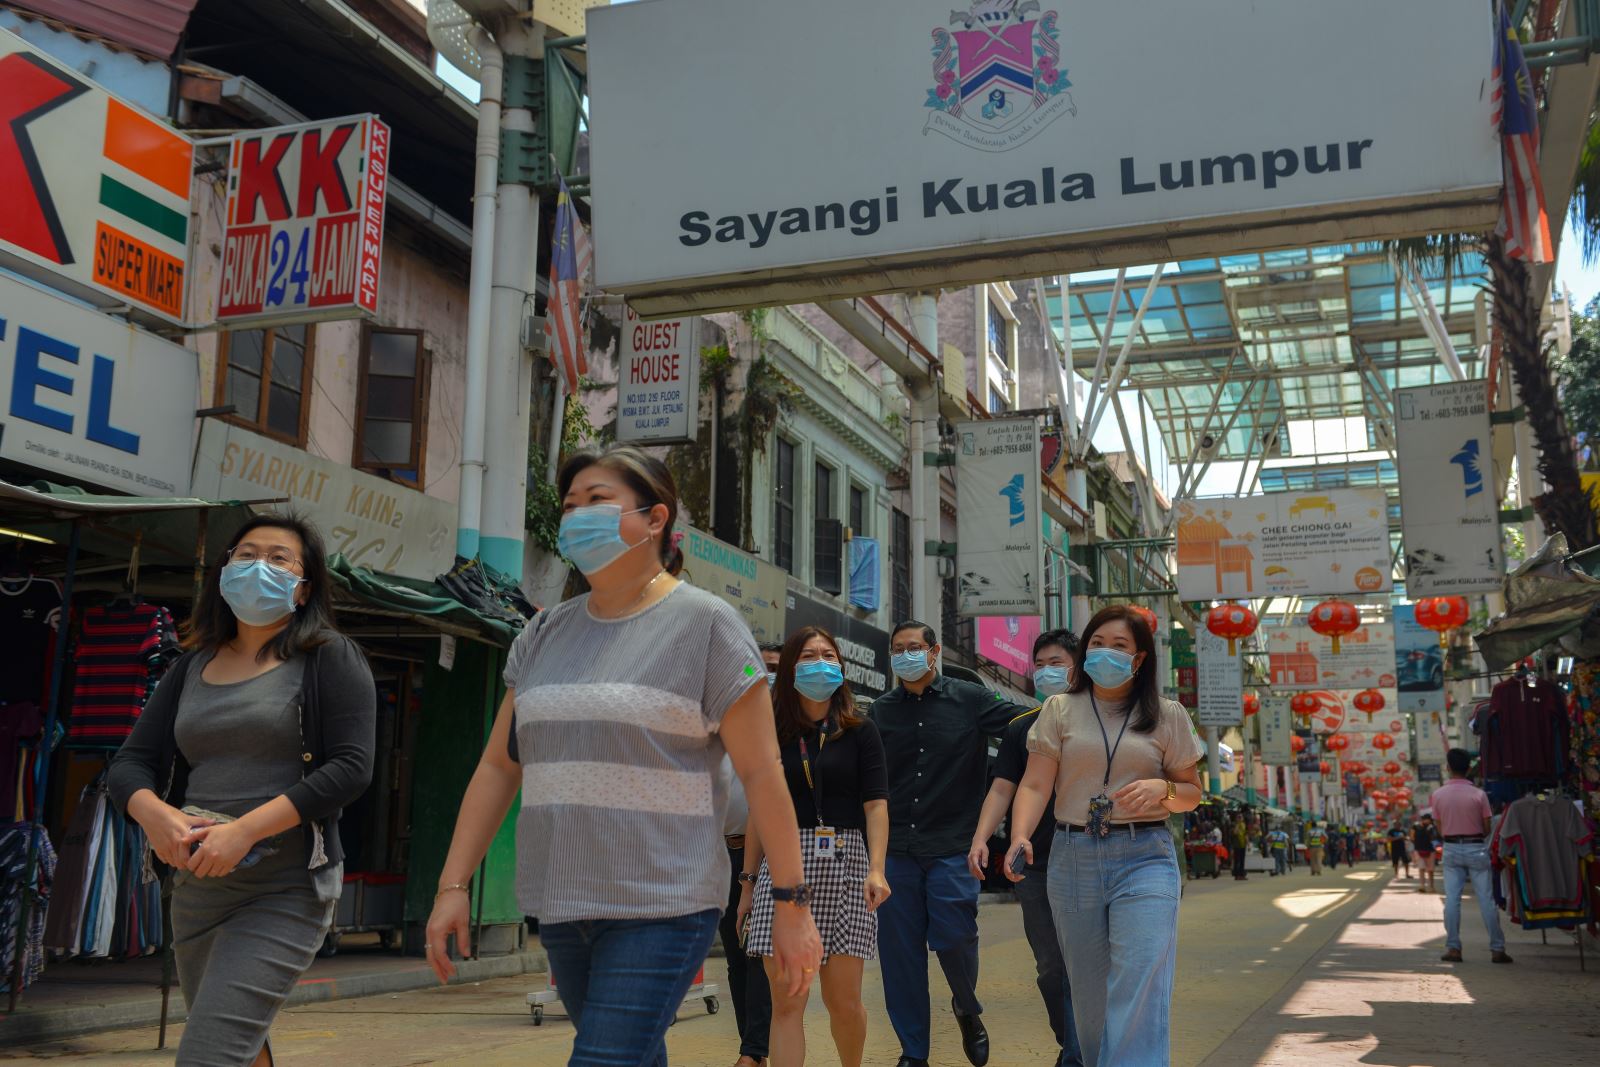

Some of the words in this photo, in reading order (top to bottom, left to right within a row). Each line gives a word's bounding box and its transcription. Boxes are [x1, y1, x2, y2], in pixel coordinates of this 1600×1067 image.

[235, 122, 359, 225] KK
[678, 186, 899, 249] Sayangi
[922, 166, 1096, 219] Kuala
[1120, 138, 1374, 196] Lumpur
[98, 231, 143, 294] SUPER
[147, 253, 184, 311] MART
[221, 233, 268, 309] BUKA
[266, 227, 310, 307] 24
[310, 220, 359, 298] JAM
[632, 321, 681, 352] GUEST
[630, 353, 680, 385] HOUSE
[660, 390, 680, 402] FLOOR
[219, 441, 330, 504] SYARIKAT
[1261, 526, 1288, 535] CHEE
[1290, 522, 1332, 533] CHIONG
[1334, 521, 1352, 530] GAI
[688, 531, 758, 582] TELEKOMUNIKASI
[1004, 543, 1032, 553] Malaysia
[1458, 578, 1477, 586] KUALA
[865, 669, 887, 692] CLUB
